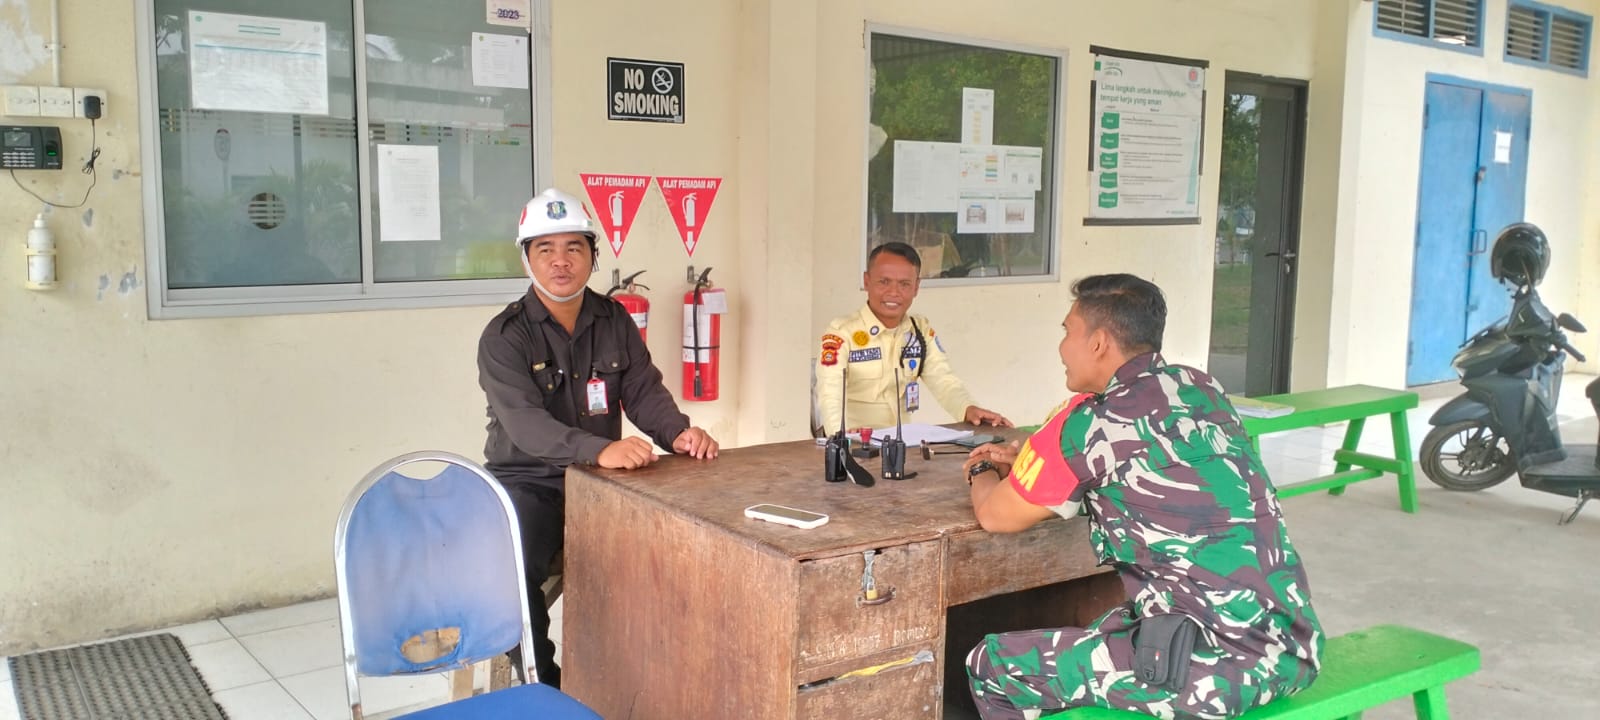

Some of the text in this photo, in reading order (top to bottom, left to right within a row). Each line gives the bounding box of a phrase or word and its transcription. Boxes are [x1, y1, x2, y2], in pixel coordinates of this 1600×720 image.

[498, 8, 519, 20] 2023
[624, 68, 645, 91] NO
[614, 92, 679, 116] SMOKING
[1100, 94, 1119, 104] tempat
[587, 176, 646, 188] ALAT PEMADAM API
[663, 179, 717, 190] ALAT PEMADAM API
